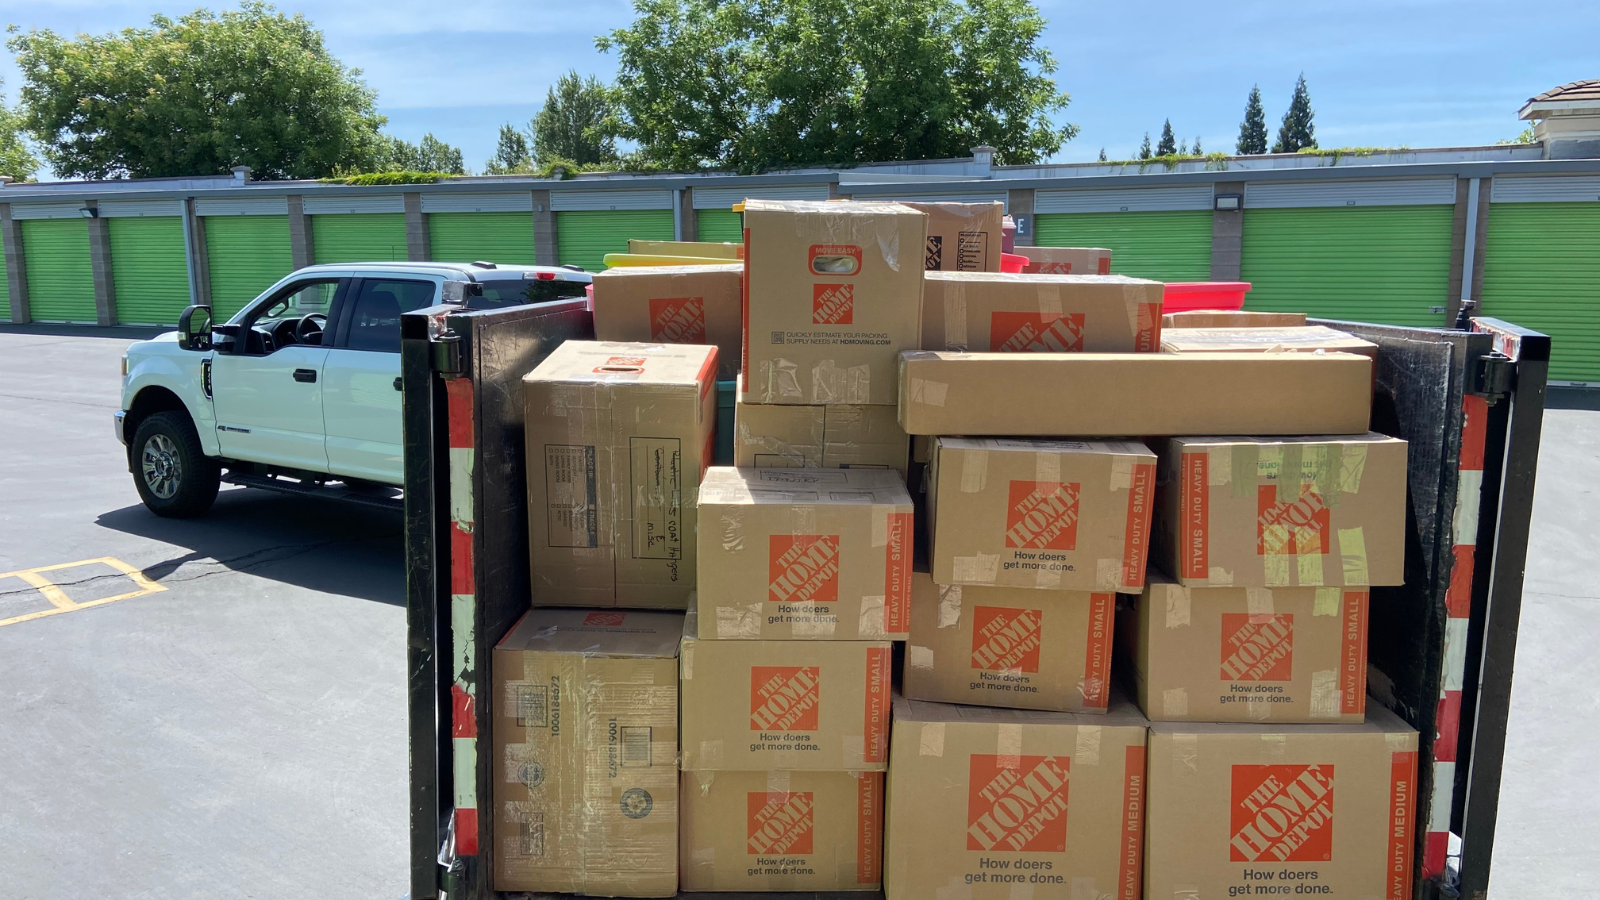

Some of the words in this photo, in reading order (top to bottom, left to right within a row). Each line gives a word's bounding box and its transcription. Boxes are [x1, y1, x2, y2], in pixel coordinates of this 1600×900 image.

[1017, 218, 1024, 233] E
[813, 284, 854, 324] HOME
[817, 288, 834, 303] THE
[656, 304, 678, 326] THE
[828, 301, 853, 324] DEPOT
[1194, 460, 1202, 493] HEAVY
[1015, 489, 1044, 515] THE
[1134, 471, 1146, 513] SMALL
[1006, 481, 1080, 548] HOME
[1194, 497, 1202, 524] DUTY
[892, 519, 902, 561] SMALL
[1033, 508, 1078, 549] DEPOT
[1132, 518, 1141, 545] DUTY
[776, 541, 805, 569] THE
[1015, 551, 1036, 560] How
[1039, 552, 1066, 561] doers
[1129, 550, 1138, 581] HEAVY
[1194, 529, 1202, 572] SMALL
[769, 535, 839, 601] HOME
[796, 560, 838, 601] DEPOT
[891, 565, 899, 591] DUTY
[1004, 561, 1019, 570] get
[1050, 563, 1076, 571] done.
[768, 615, 784, 624] get
[814, 615, 839, 623] done.
[778, 605, 800, 613] How
[802, 605, 830, 613] doers
[1094, 599, 1105, 638] SMALL
[1348, 598, 1359, 640] SMALL
[972, 609, 1041, 669] HOME
[980, 614, 1008, 639] THE
[1229, 621, 1257, 647] THE
[998, 634, 1040, 670] DEPOT
[1093, 643, 1102, 667] DUTY
[1221, 614, 1294, 681] HOME
[1249, 638, 1293, 681] DEPOT
[1348, 644, 1356, 671] DUTY
[757, 673, 786, 699] THE
[871, 654, 880, 693] SMALL
[970, 682, 985, 690] get
[987, 683, 1011, 691] more
[1014, 684, 1039, 693] done.
[980, 672, 1000, 681] How
[1003, 674, 1030, 683] doers
[750, 667, 819, 730] HOME
[1220, 695, 1236, 704] get
[1267, 694, 1293, 703] done.
[1230, 685, 1252, 693] How
[1255, 685, 1283, 693] doers
[1347, 675, 1355, 707] HEAVY
[777, 690, 819, 730] DEPOT
[871, 697, 880, 723] DUTY
[750, 743, 765, 751] get
[794, 743, 820, 751] done.
[760, 733, 781, 741] How
[783, 733, 810, 741] doers
[870, 727, 879, 757] HEAVY
[863, 777, 871, 815] SMALL
[978, 768, 1021, 804] THE
[1241, 774, 1284, 814] THE
[754, 799, 782, 824] THE
[967, 755, 1070, 851] HOME
[1128, 775, 1140, 832] MEDIUM
[1230, 765, 1334, 862] HOME
[1395, 780, 1406, 837] MEDIUM
[748, 792, 813, 854] HOME
[773, 814, 813, 854] DEPOT
[1006, 792, 1068, 851] DEPOT
[1270, 800, 1333, 862] DEPOT
[979, 858, 1010, 869] How
[1014, 859, 1053, 869] doers
[1127, 836, 1136, 865] DUTY
[1394, 842, 1404, 872] DUTY
[748, 867, 762, 876] get
[791, 867, 815, 875] done.
[965, 872, 986, 885] get
[991, 874, 1026, 883] more
[1030, 873, 1067, 884] done.
[1243, 870, 1275, 880] How
[1278, 869, 1318, 880] doers
[1229, 884, 1251, 897] get
[1255, 886, 1290, 894] more
[1295, 884, 1333, 894] done.
